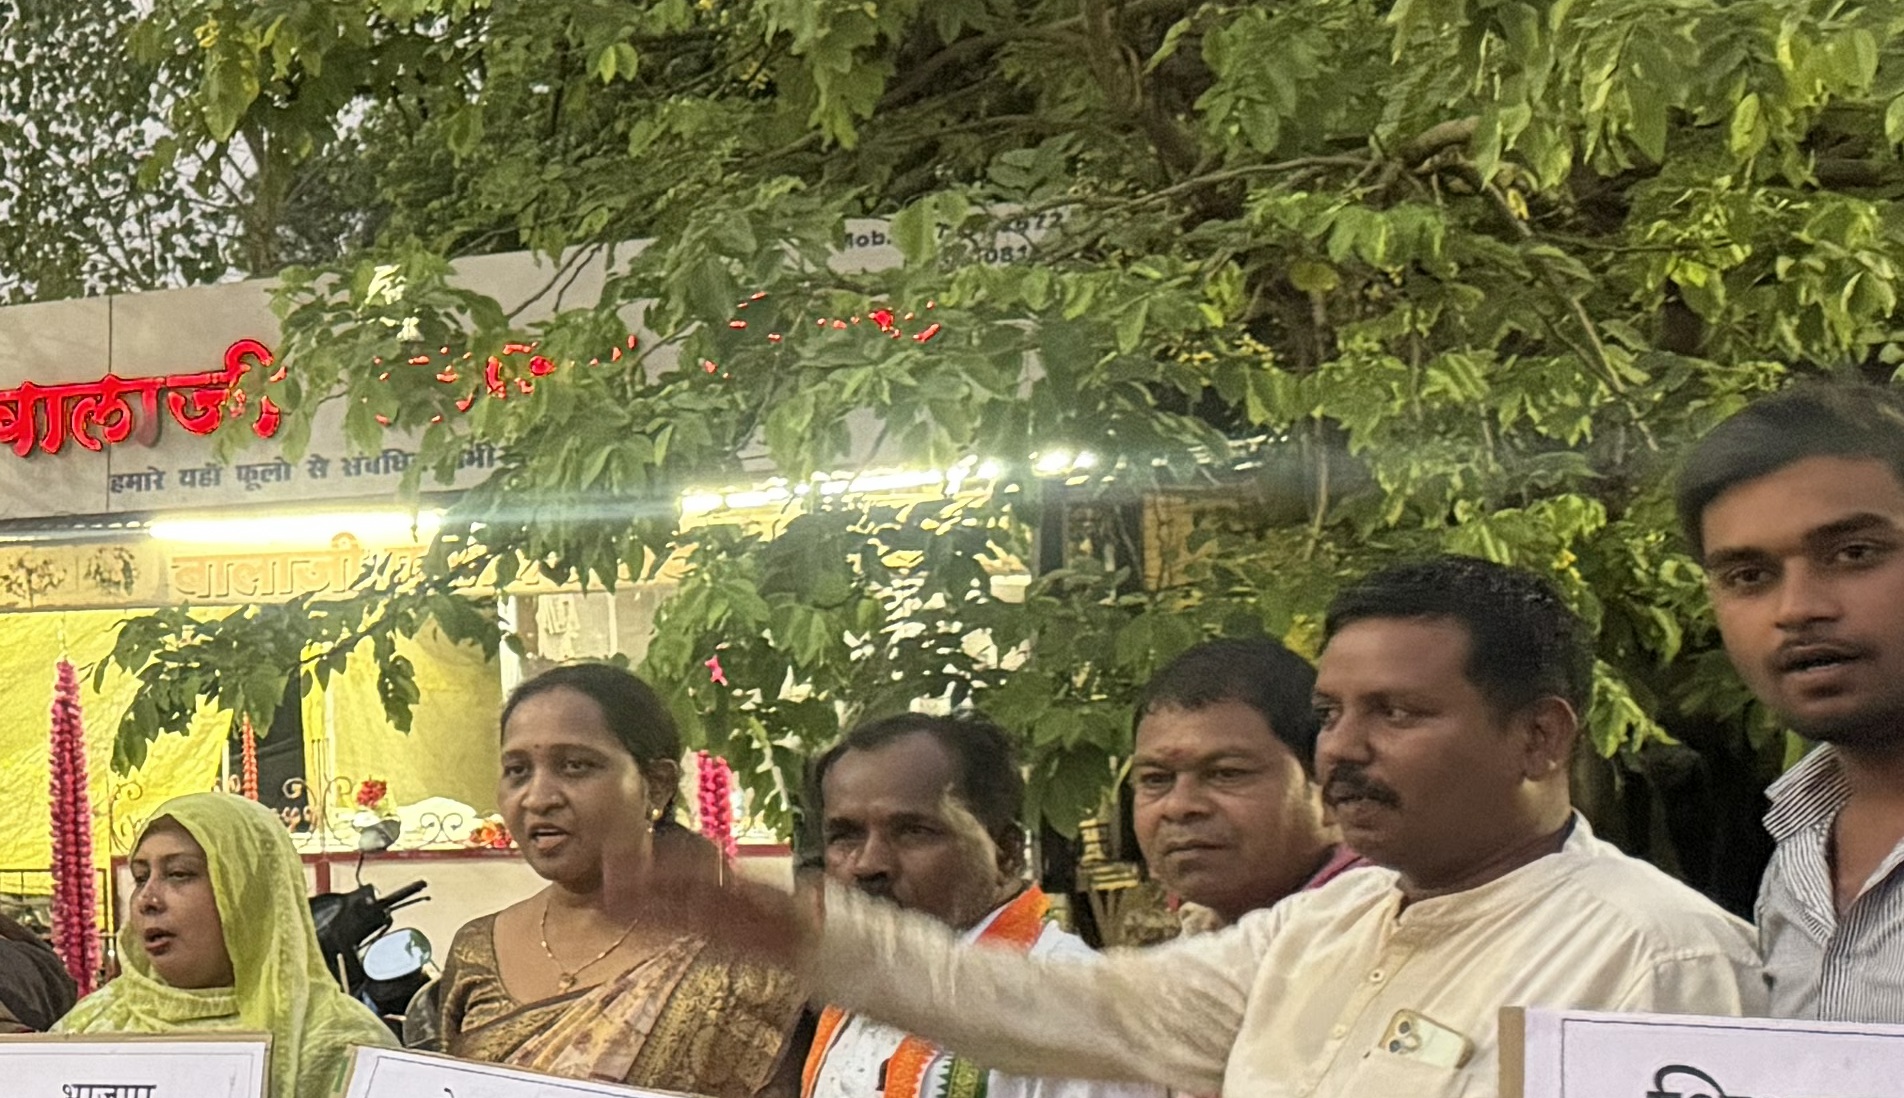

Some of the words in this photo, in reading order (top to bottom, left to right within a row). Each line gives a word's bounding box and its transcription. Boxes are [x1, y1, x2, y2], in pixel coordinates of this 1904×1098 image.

[110, 466, 165, 494] हमारे
[307, 453, 330, 479] से
[171, 531, 364, 598] बालाजी
